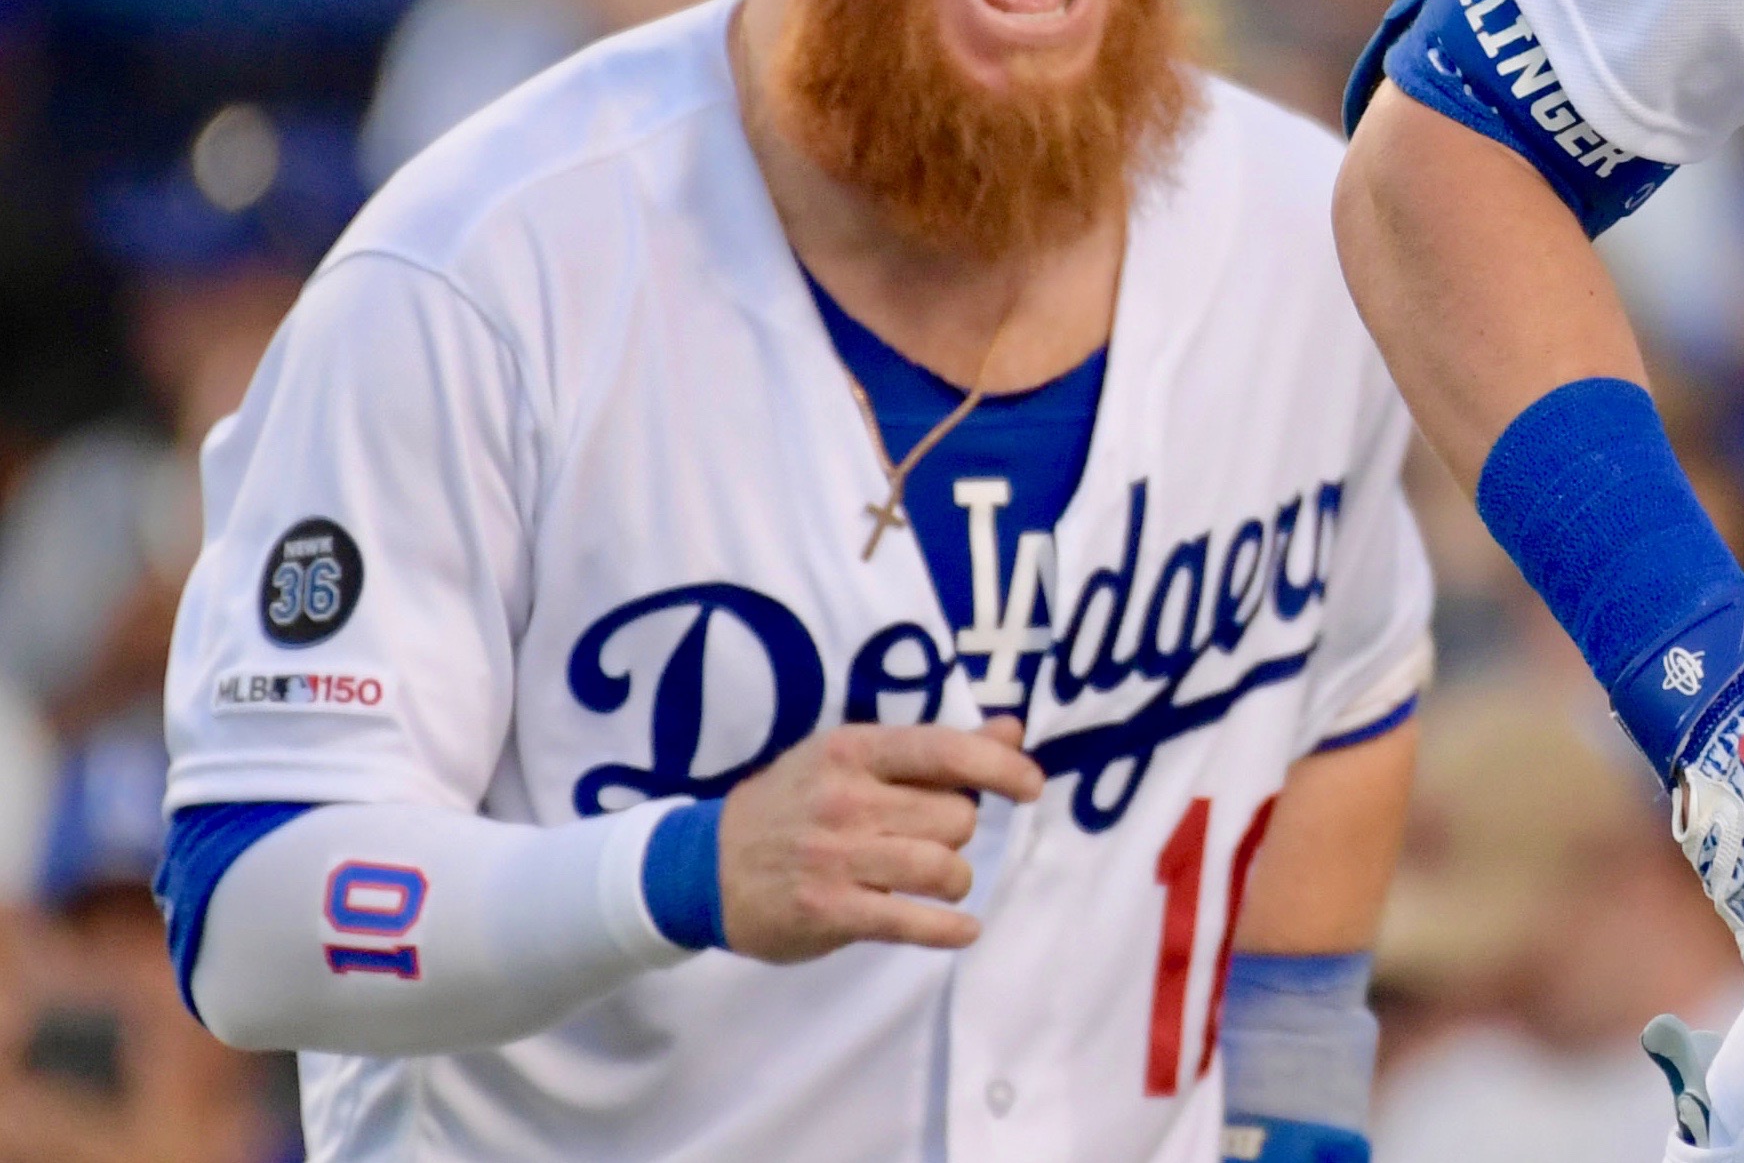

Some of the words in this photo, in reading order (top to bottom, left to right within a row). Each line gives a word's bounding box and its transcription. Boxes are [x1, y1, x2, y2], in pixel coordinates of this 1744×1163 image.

[269, 556, 342, 626] 36
[217, 676, 267, 704] MLB
[319, 674, 384, 707] 150
[322, 859, 430, 980] 10
